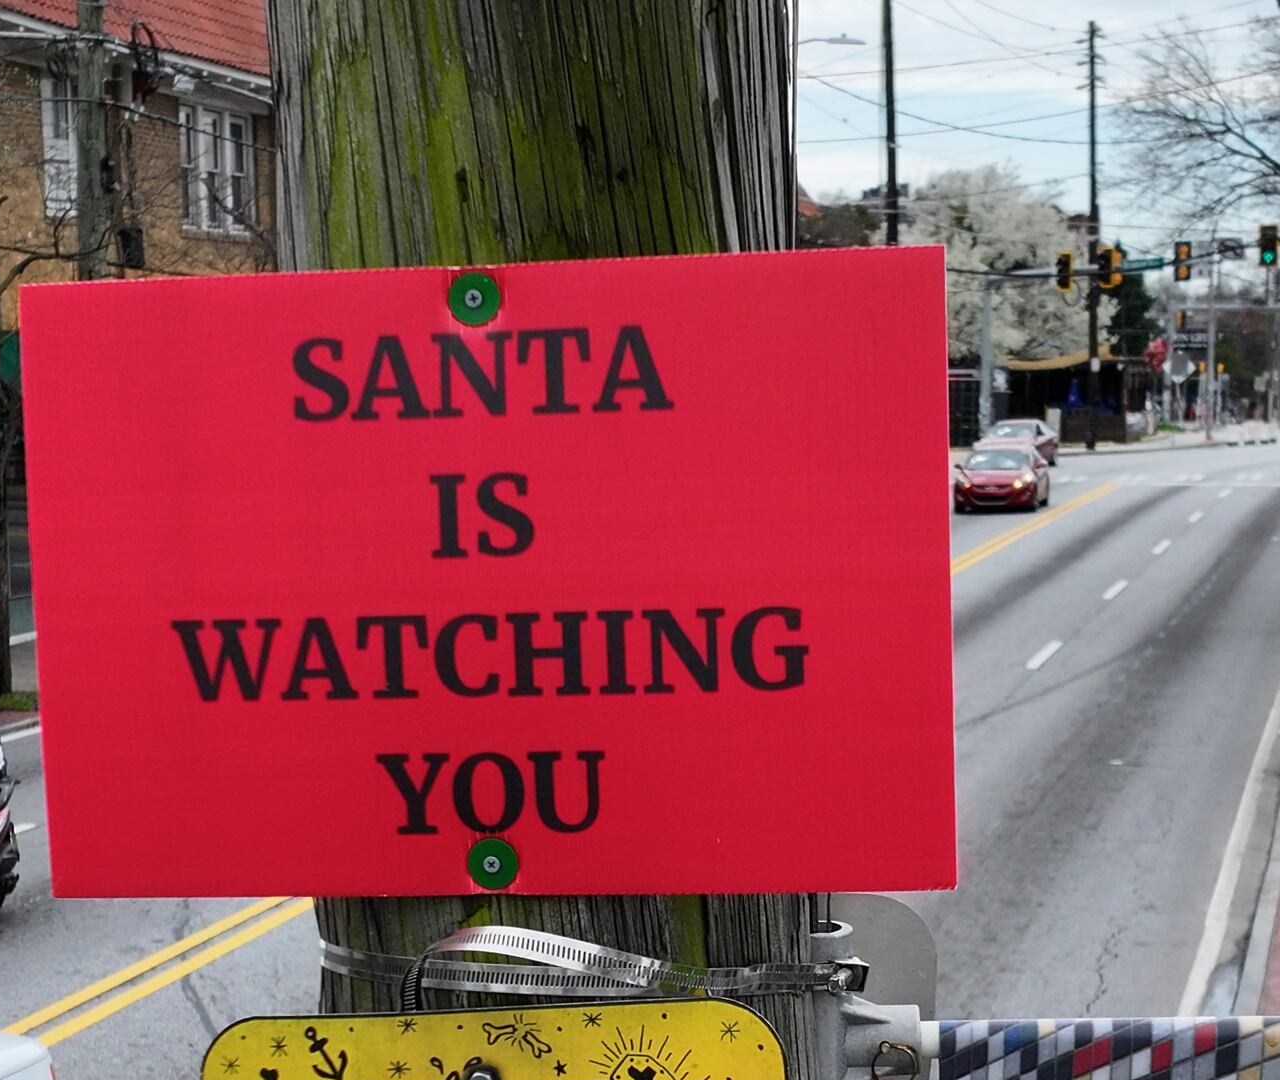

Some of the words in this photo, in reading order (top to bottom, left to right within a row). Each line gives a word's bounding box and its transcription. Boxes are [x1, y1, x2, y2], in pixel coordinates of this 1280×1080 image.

[292, 324, 674, 421] SANTA
[429, 472, 535, 559] IS
[172, 606, 810, 703] WATCHING
[375, 750, 606, 836] YOU
